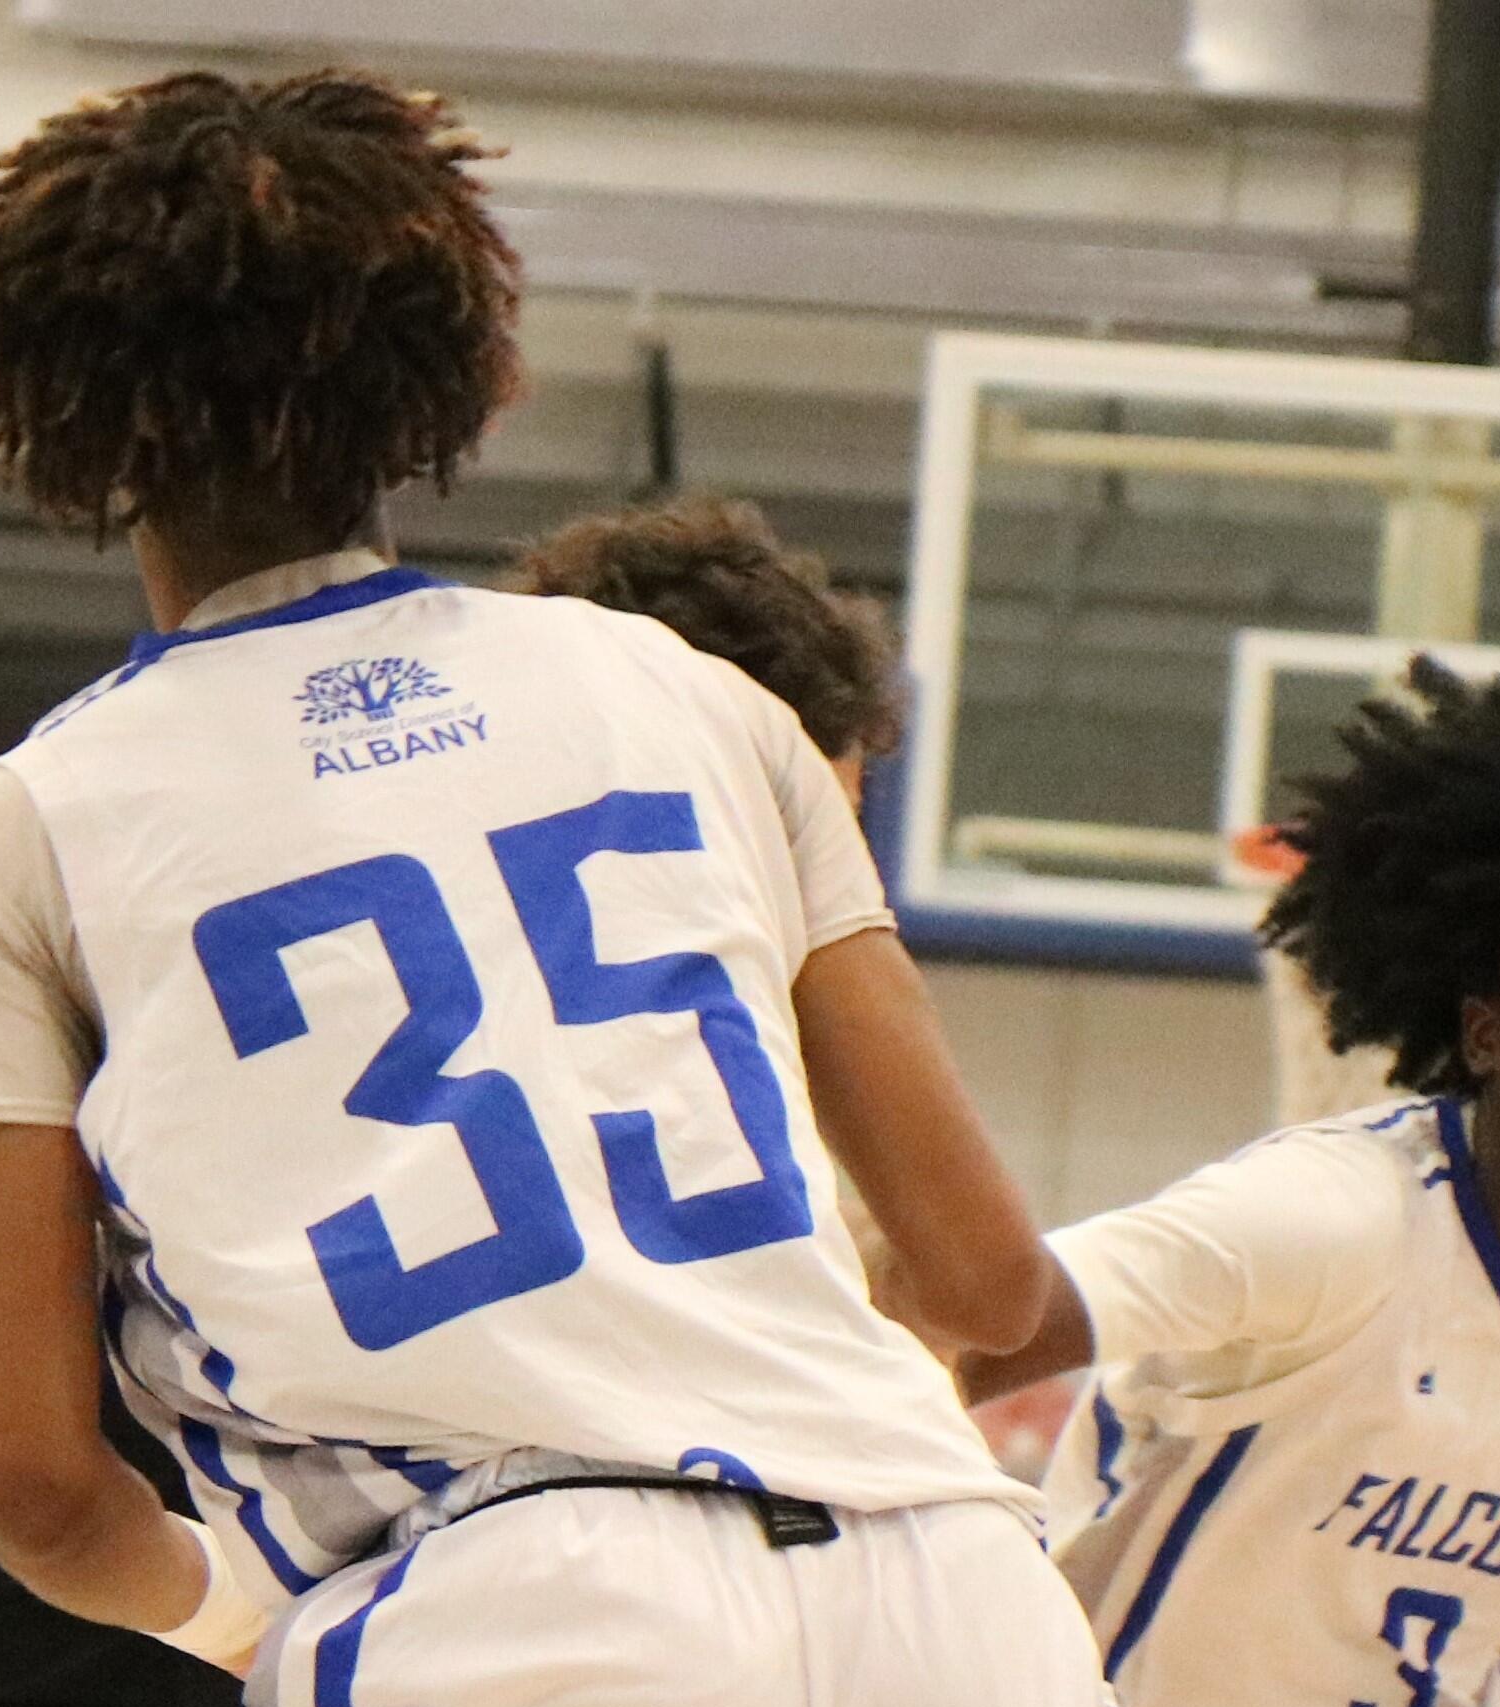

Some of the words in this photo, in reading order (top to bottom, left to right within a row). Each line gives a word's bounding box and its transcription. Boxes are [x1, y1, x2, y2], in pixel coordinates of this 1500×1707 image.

[299, 734, 333, 750] City
[336, 722, 395, 744] School
[398, 706, 456, 729] District
[313, 713, 487, 779] ALBANY
[192, 790, 814, 1352] 35
